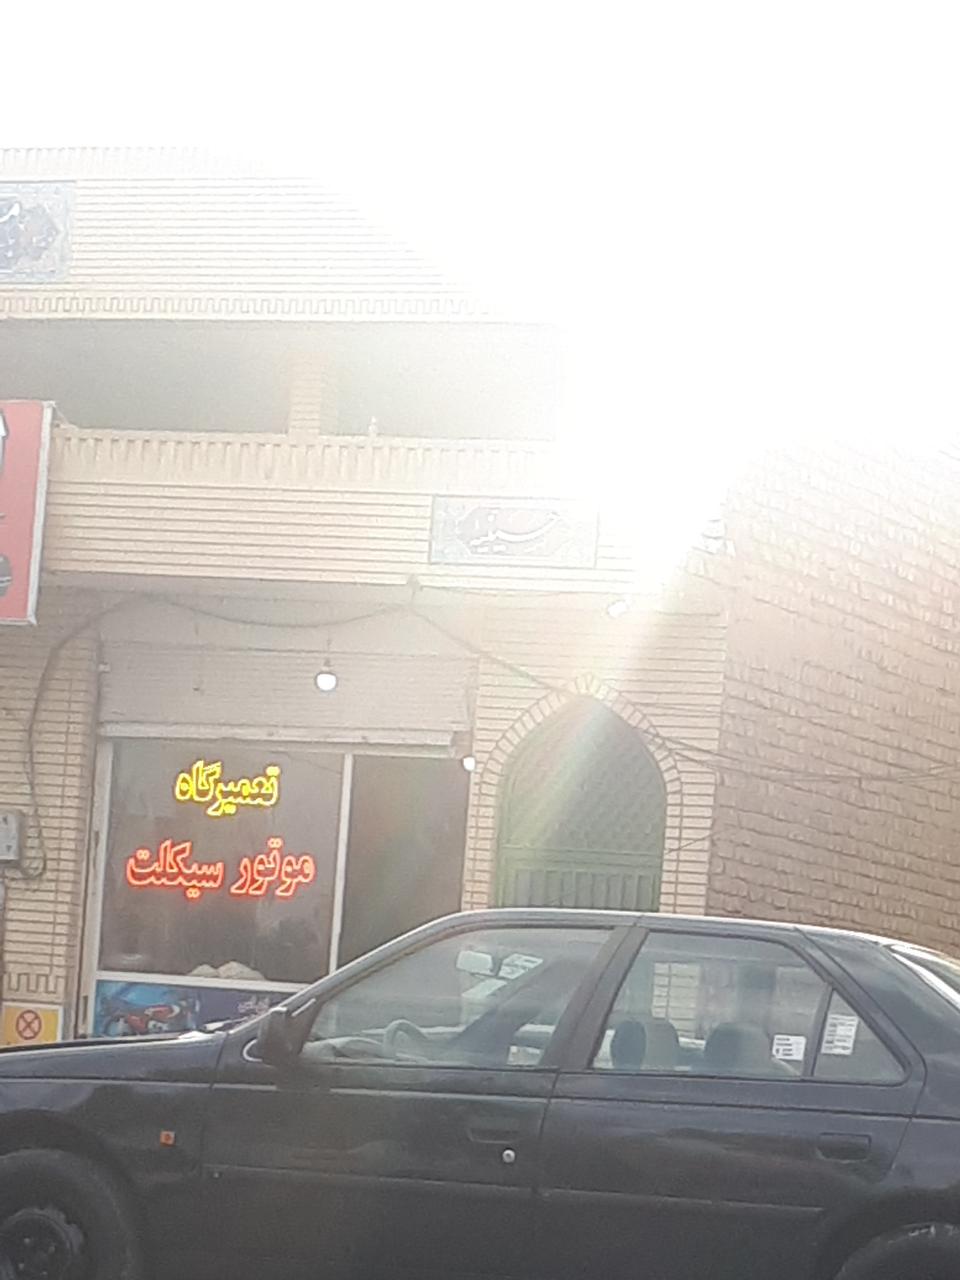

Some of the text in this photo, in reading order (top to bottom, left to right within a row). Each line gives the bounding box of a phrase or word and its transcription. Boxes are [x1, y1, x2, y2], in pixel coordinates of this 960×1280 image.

[175, 760, 281, 816] تعمیرگاه
[126, 837, 315, 898] موتور سیکلت
